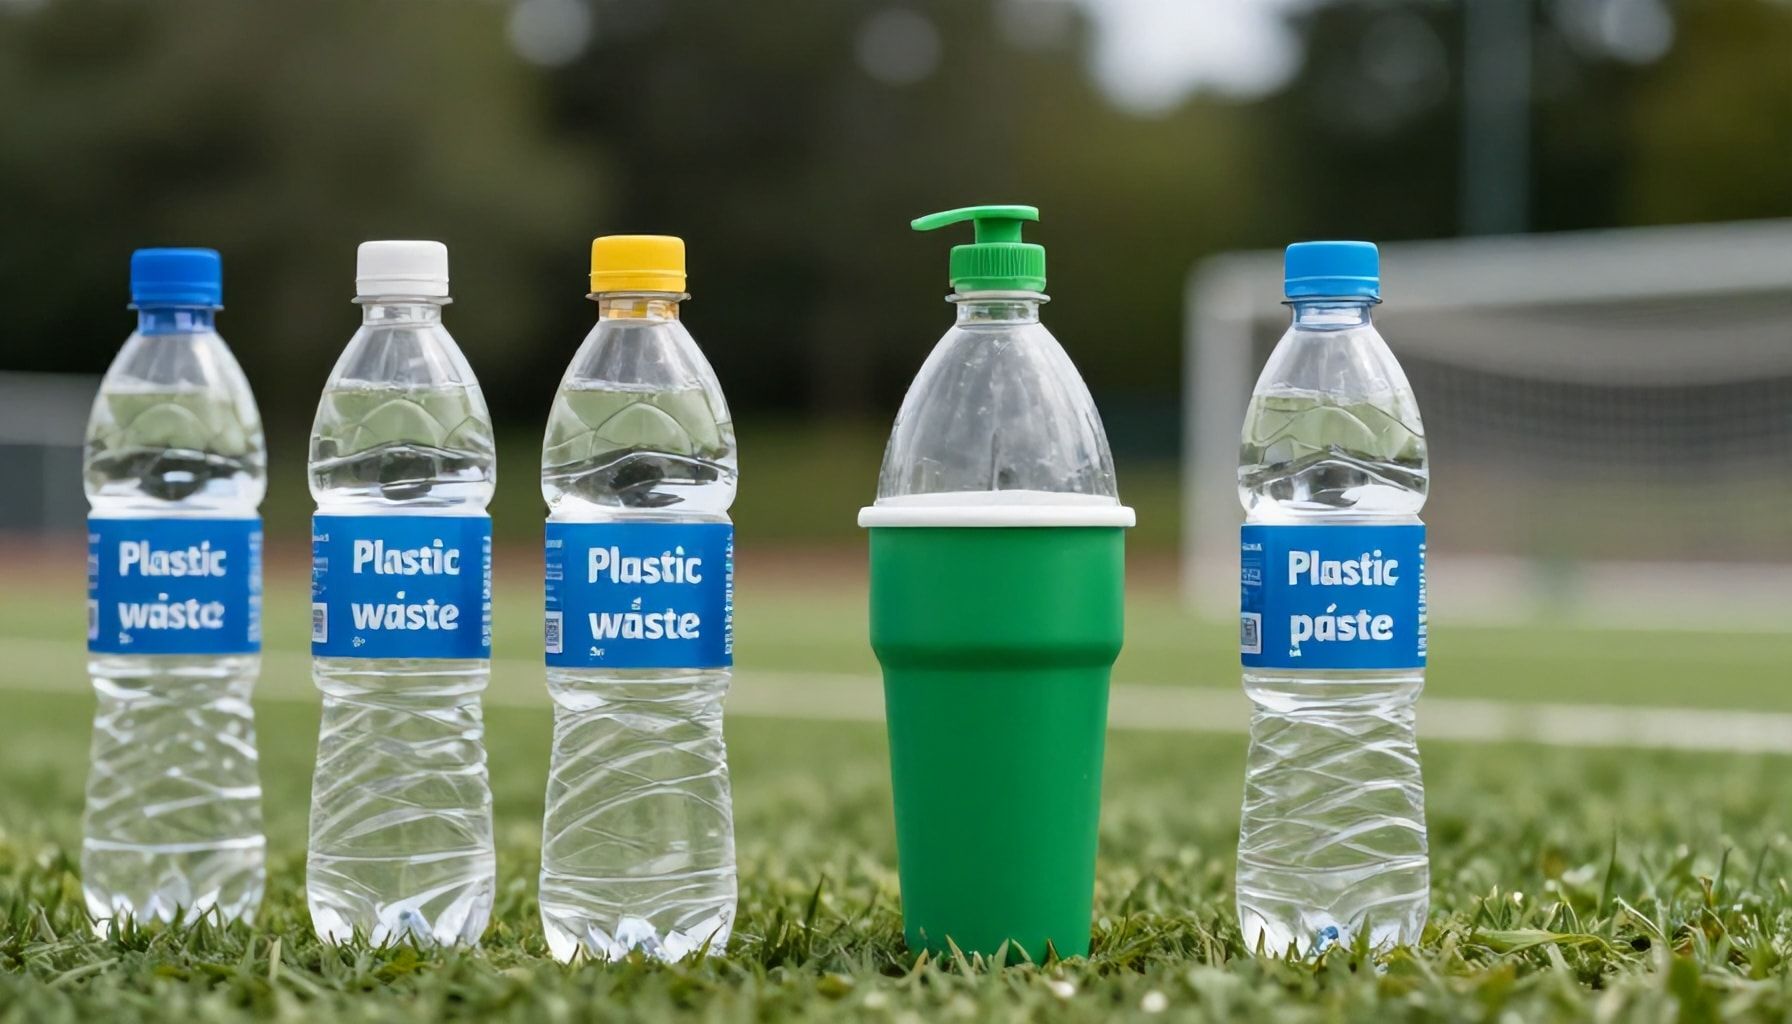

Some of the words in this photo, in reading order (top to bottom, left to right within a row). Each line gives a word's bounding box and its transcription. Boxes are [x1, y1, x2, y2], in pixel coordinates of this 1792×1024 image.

[118, 540, 227, 577] Plastic
[353, 538, 460, 575] Plastic
[588, 545, 702, 584] Plastic
[1288, 549, 1399, 586] Plastic
